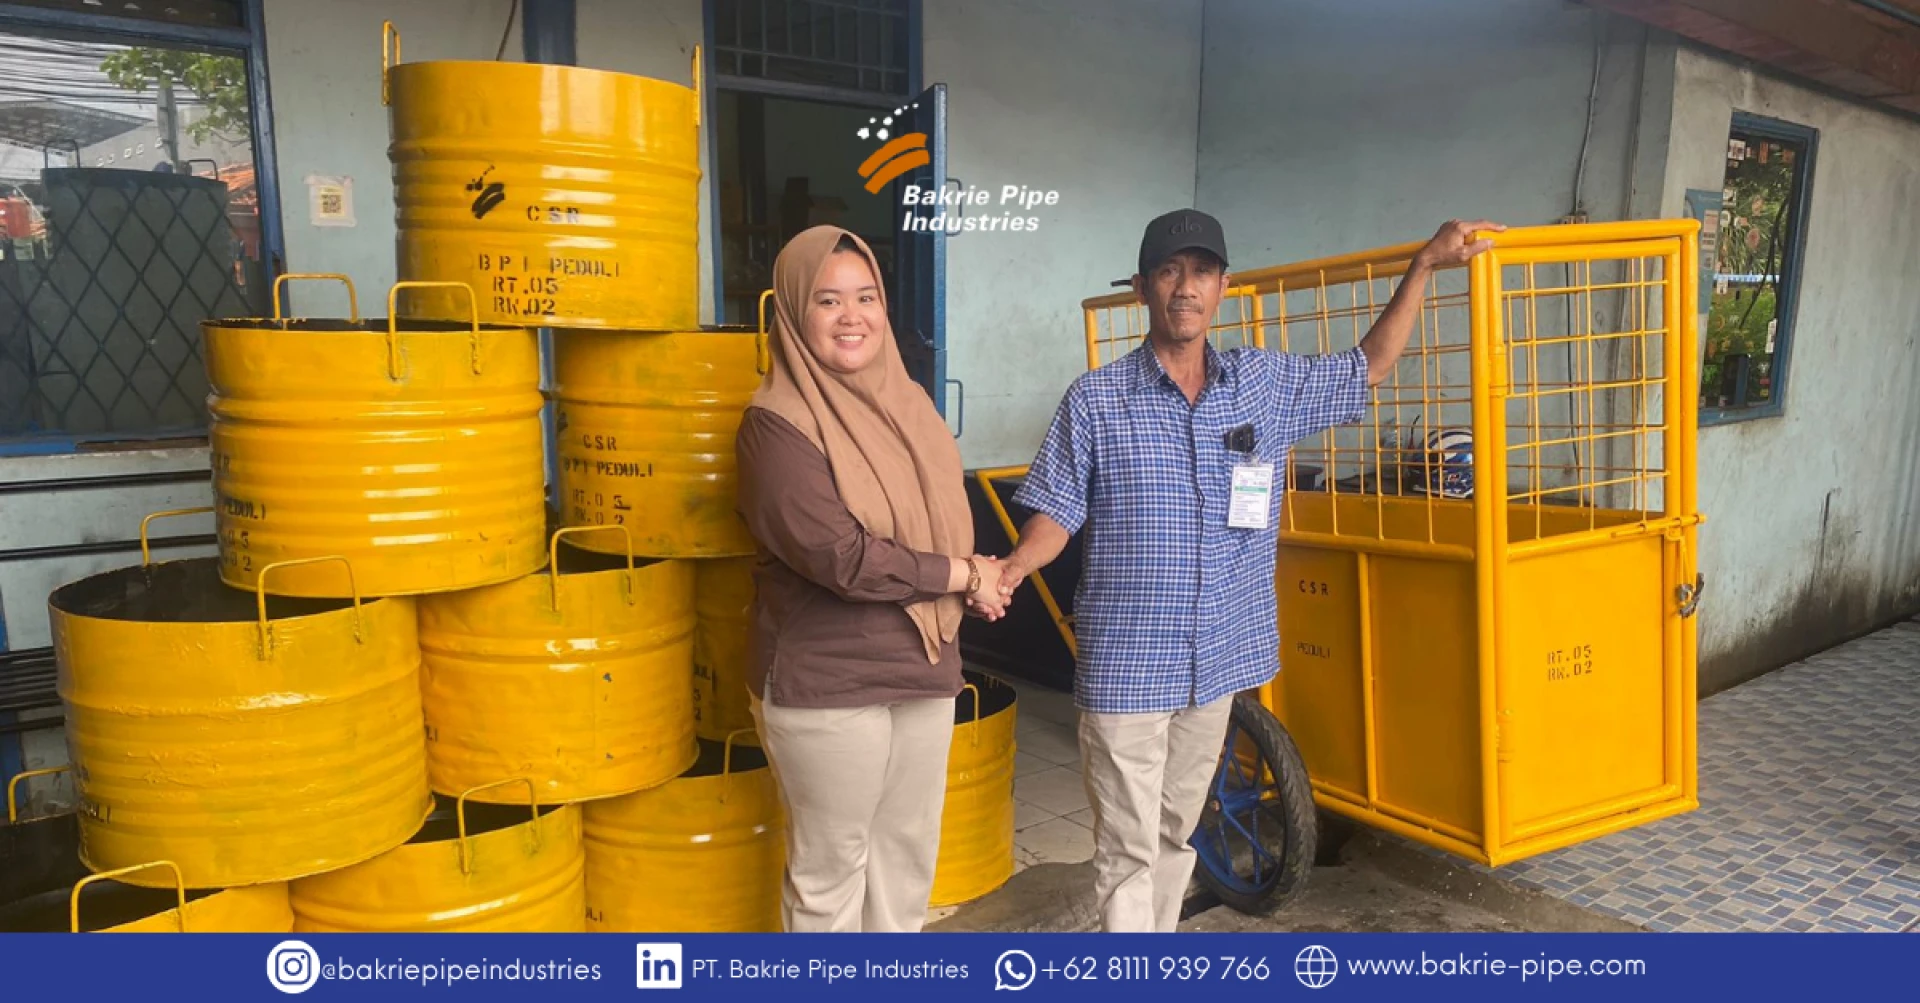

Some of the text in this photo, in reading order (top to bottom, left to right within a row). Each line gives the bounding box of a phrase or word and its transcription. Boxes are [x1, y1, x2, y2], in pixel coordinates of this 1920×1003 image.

[527, 205, 580, 224] CSR
[549, 257, 620, 277] PEDULI
[493, 276, 559, 295] RT.05
[583, 434, 618, 451] CSR
[596, 461, 654, 477] PEDULI
[1298, 579, 1329, 596] CSR
